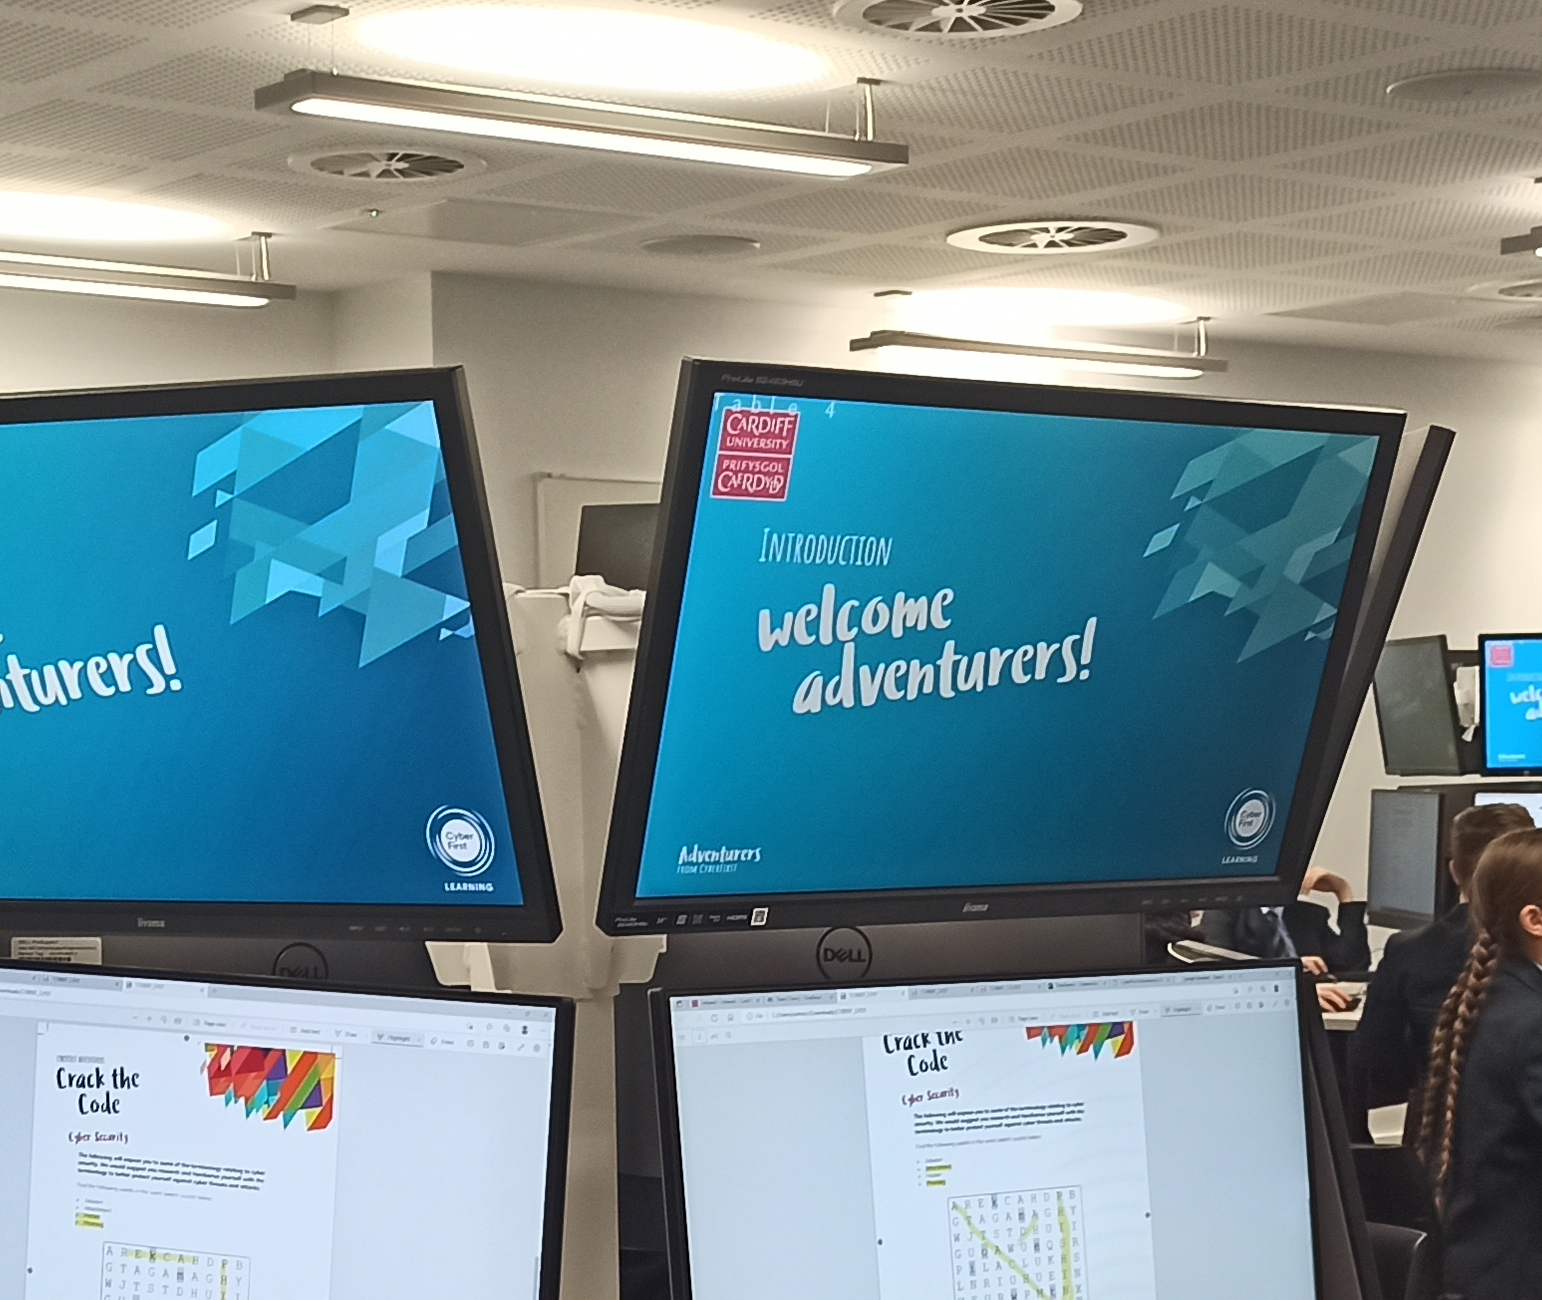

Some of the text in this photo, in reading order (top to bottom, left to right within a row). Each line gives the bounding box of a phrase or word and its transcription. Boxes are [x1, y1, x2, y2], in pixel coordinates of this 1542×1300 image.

[824, 402, 836, 418] 4
[727, 413, 795, 436] CARDIFF
[726, 436, 790, 450] UNIVERSITY
[722, 460, 784, 474] PRIFYSGOL
[759, 583, 954, 652] welcome
[792, 616, 1097, 714] adventurers!
[445, 831, 474, 843] Cyber
[447, 841, 468, 850] First
[678, 843, 762, 865] Adventurers
[444, 882, 494, 892] LEARNING
[823, 947, 867, 963] DELL
[883, 1032, 932, 1055] Crack
[907, 1048, 949, 1077] Code
[56, 1066, 140, 1090] Crack the
[78, 1090, 121, 1115] Code
